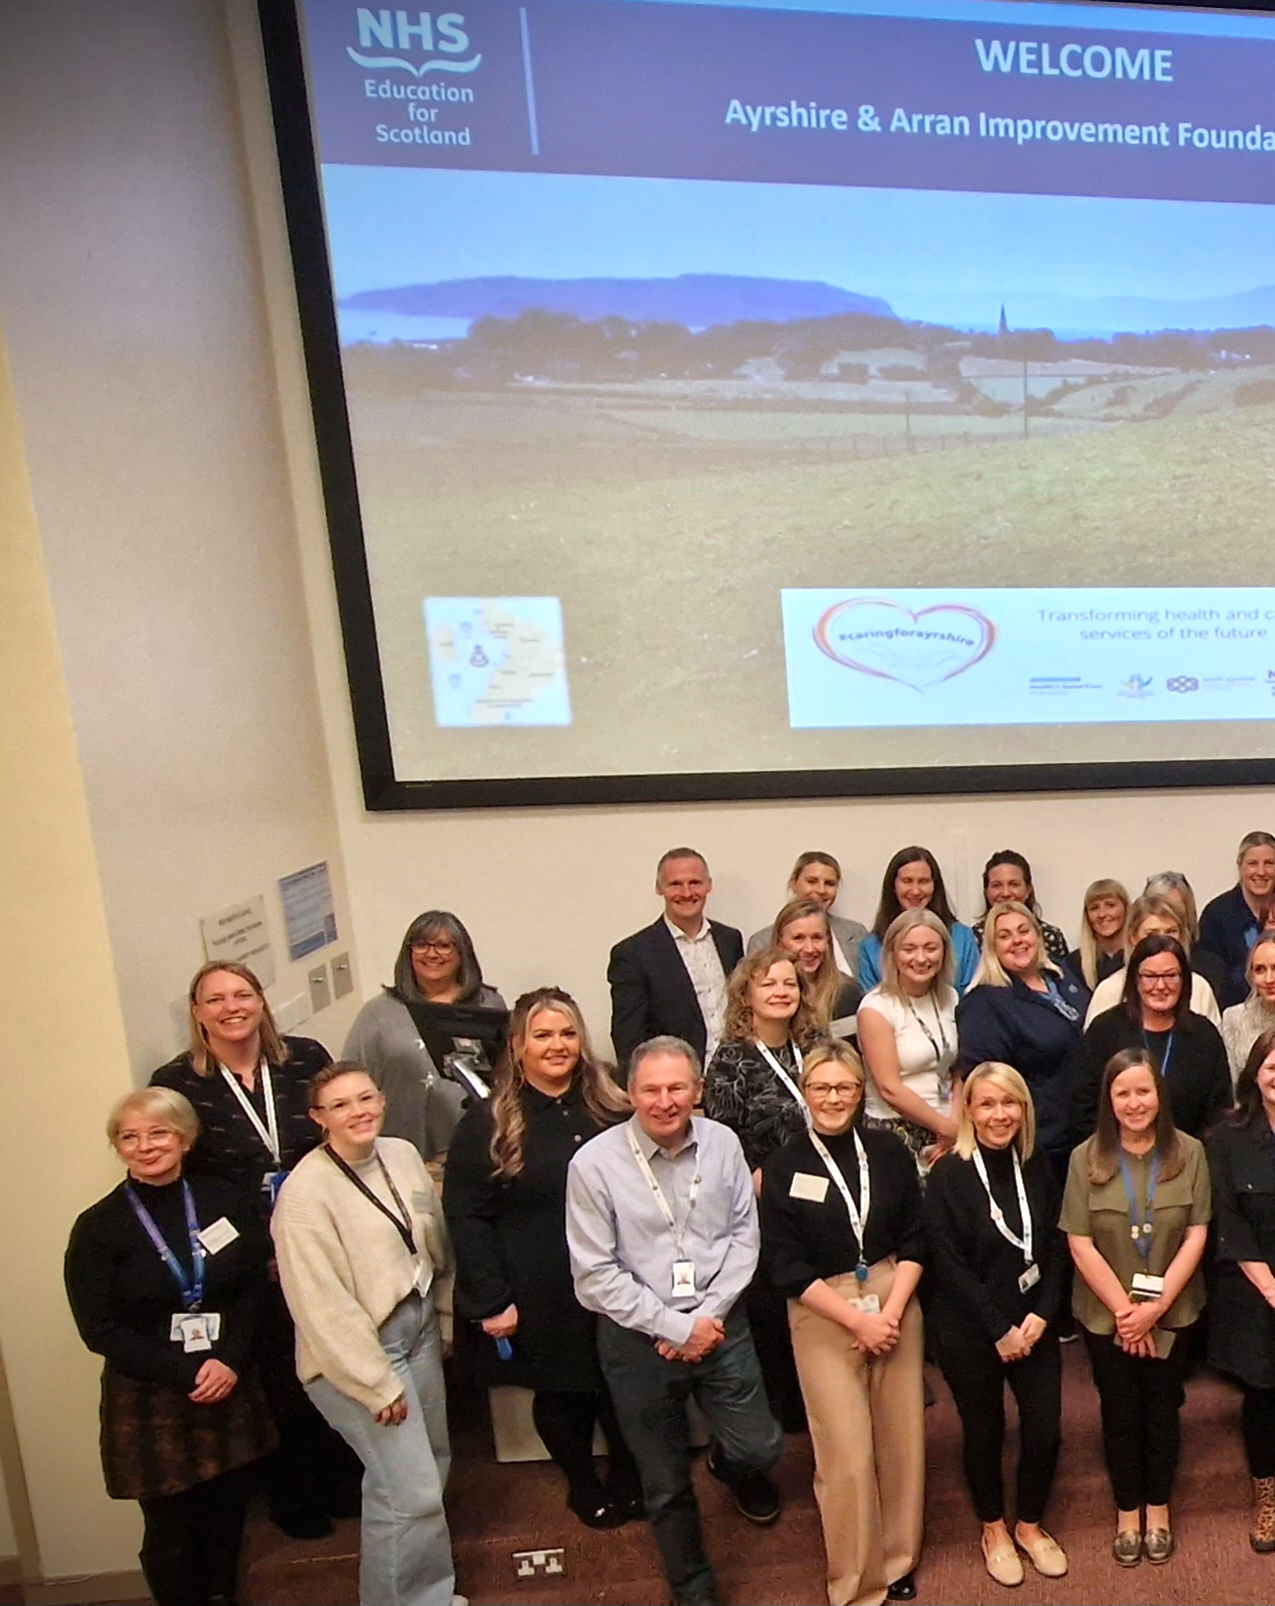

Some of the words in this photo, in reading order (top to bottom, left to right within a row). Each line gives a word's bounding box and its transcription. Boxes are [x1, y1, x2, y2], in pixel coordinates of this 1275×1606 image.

[357, 7, 470, 53] NHS
[974, 38, 1174, 82] WELCOME
[364, 78, 474, 102] Education
[408, 101, 439, 122] for
[725, 98, 848, 132] Ayrshire
[857, 103, 881, 132] &
[890, 107, 970, 136] Arran
[979, 111, 1170, 146] Improvement
[375, 124, 471, 145] Scotland
[1037, 608, 1160, 624] Transforming
[1164, 608, 1220, 622] health
[1225, 608, 1259, 621] and
[1079, 627, 1152, 641] services
[1156, 627, 1175, 640] of
[1180, 626, 1210, 640] the
[1214, 625, 1268, 640] future
